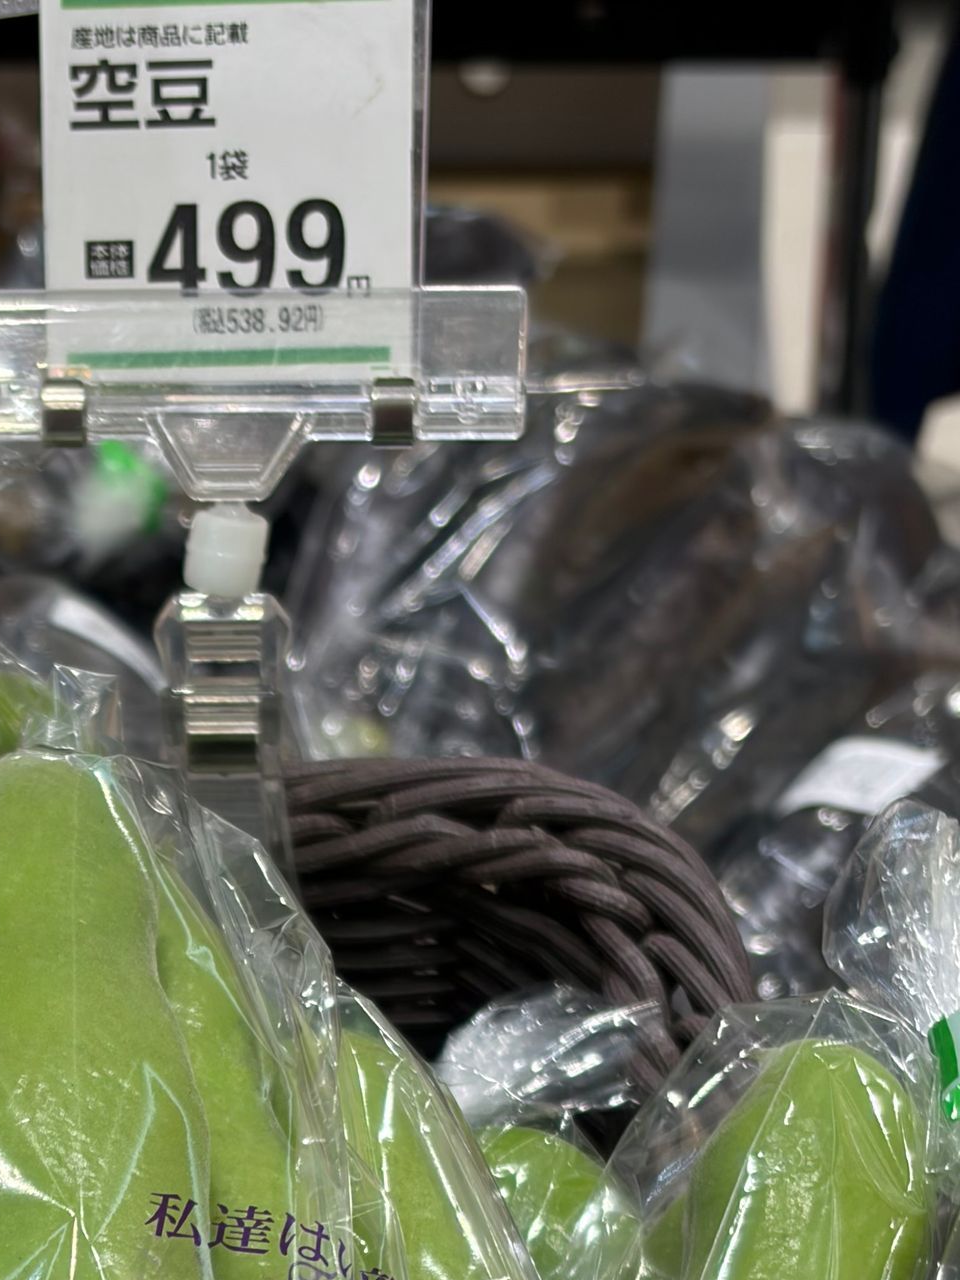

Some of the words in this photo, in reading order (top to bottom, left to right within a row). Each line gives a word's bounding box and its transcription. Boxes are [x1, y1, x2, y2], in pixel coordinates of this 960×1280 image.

[71, 21, 248, 49] 産地は商品に記載
[69, 59, 216, 131] 空豆
[206, 149, 249, 181] 1袋
